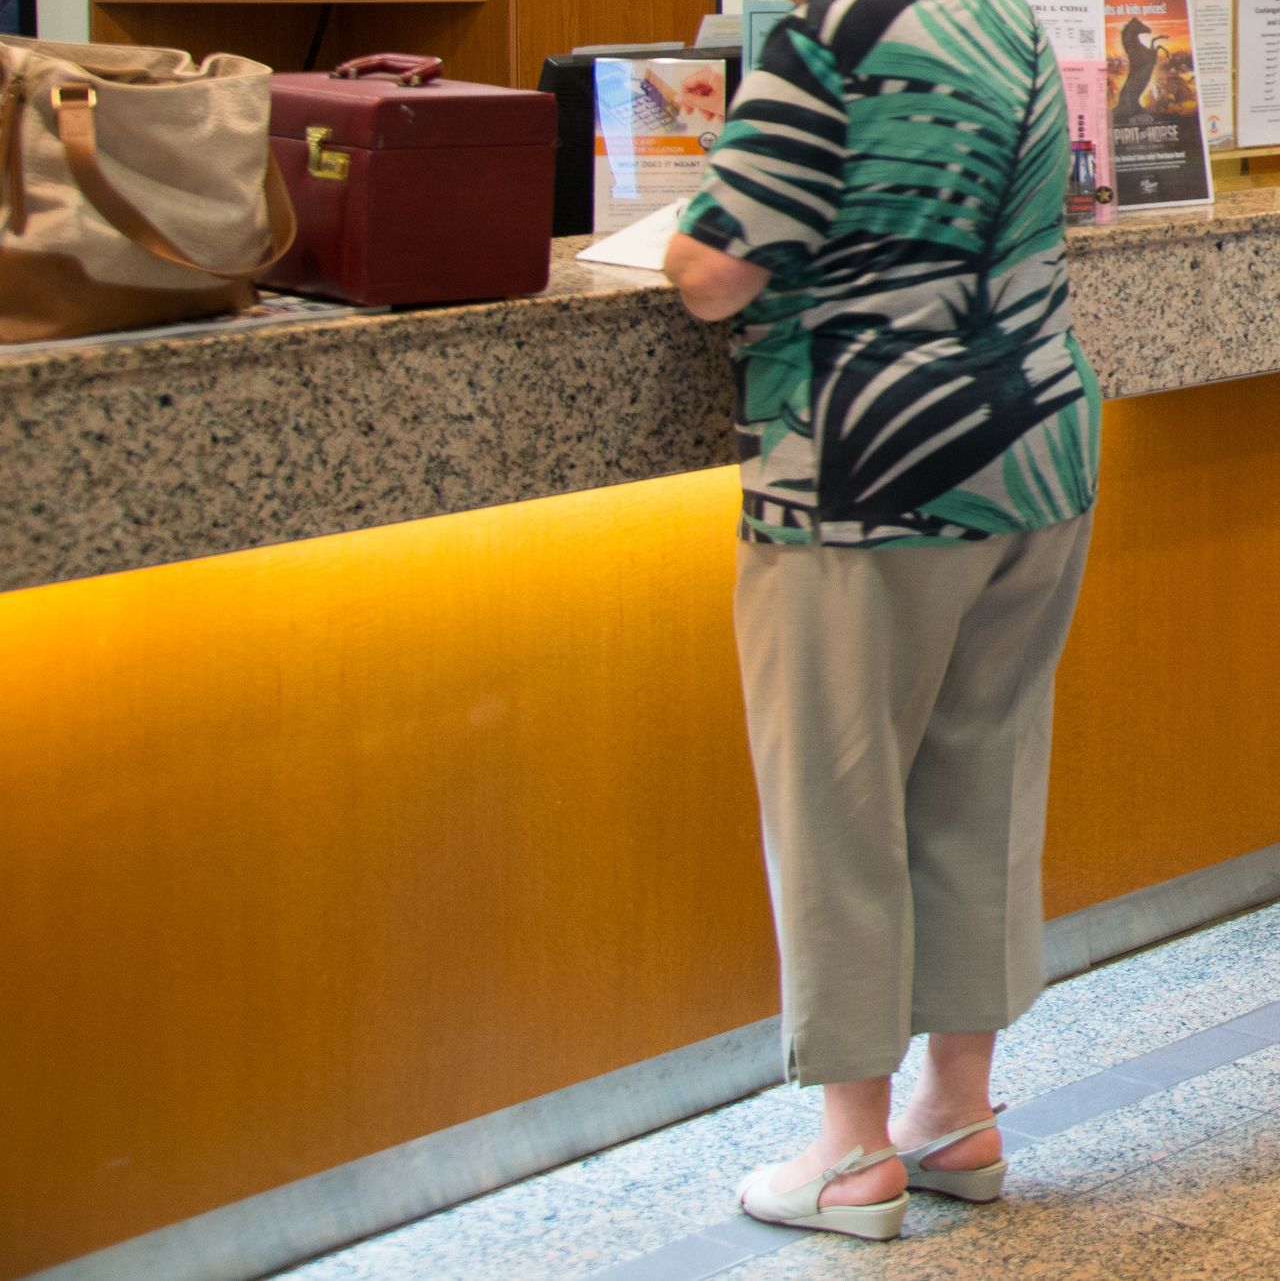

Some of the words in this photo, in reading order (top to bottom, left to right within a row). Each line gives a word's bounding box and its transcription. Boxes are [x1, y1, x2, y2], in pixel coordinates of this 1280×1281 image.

[1125, 4, 1141, 15] kids
[1142, 2, 1167, 16] prices!
[1114, 127, 1139, 145] PIRIT
[1147, 125, 1179, 142] HORSE
